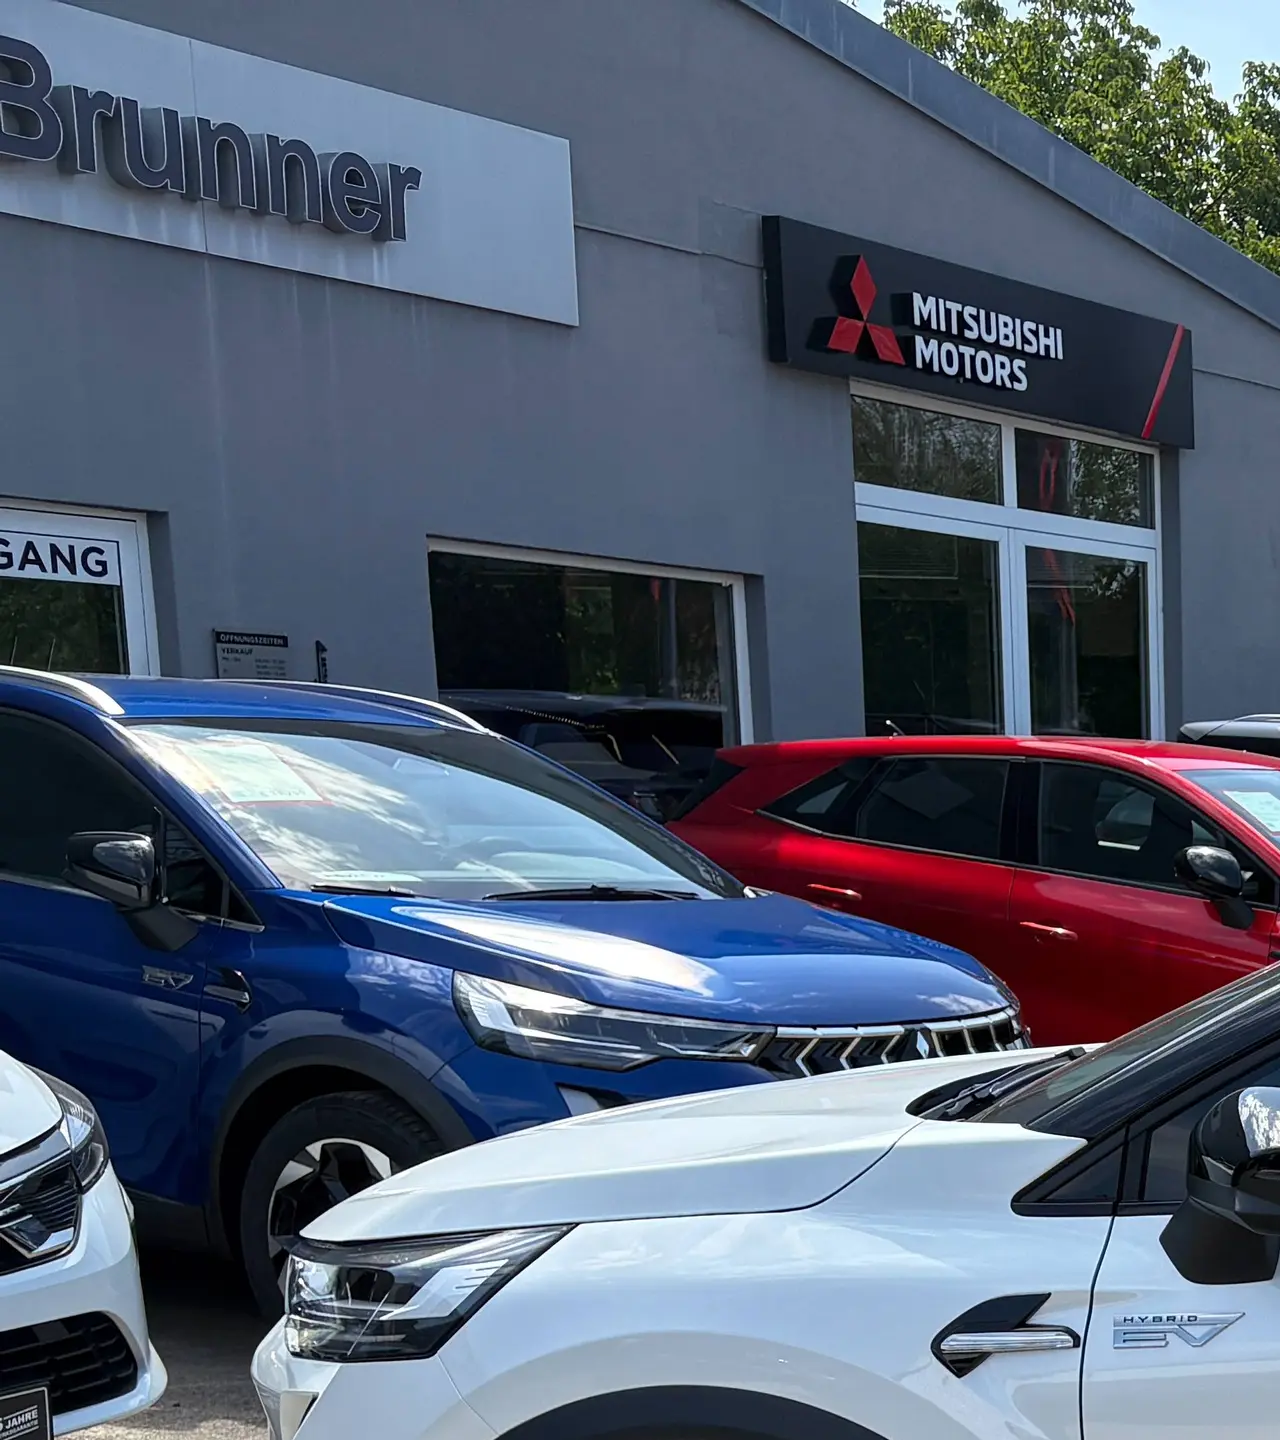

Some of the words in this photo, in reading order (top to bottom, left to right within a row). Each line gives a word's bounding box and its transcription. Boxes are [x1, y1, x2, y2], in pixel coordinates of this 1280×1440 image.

[0, 35, 422, 242] Brunner
[912, 291, 1064, 360] MITSUBISHI
[914, 335, 1028, 391] MOTORS
[1112, 1321, 1242, 1350] EV
[1122, 1314, 1199, 1324] HYBRID
[5, 1409, 39, 1430] JAHRE
